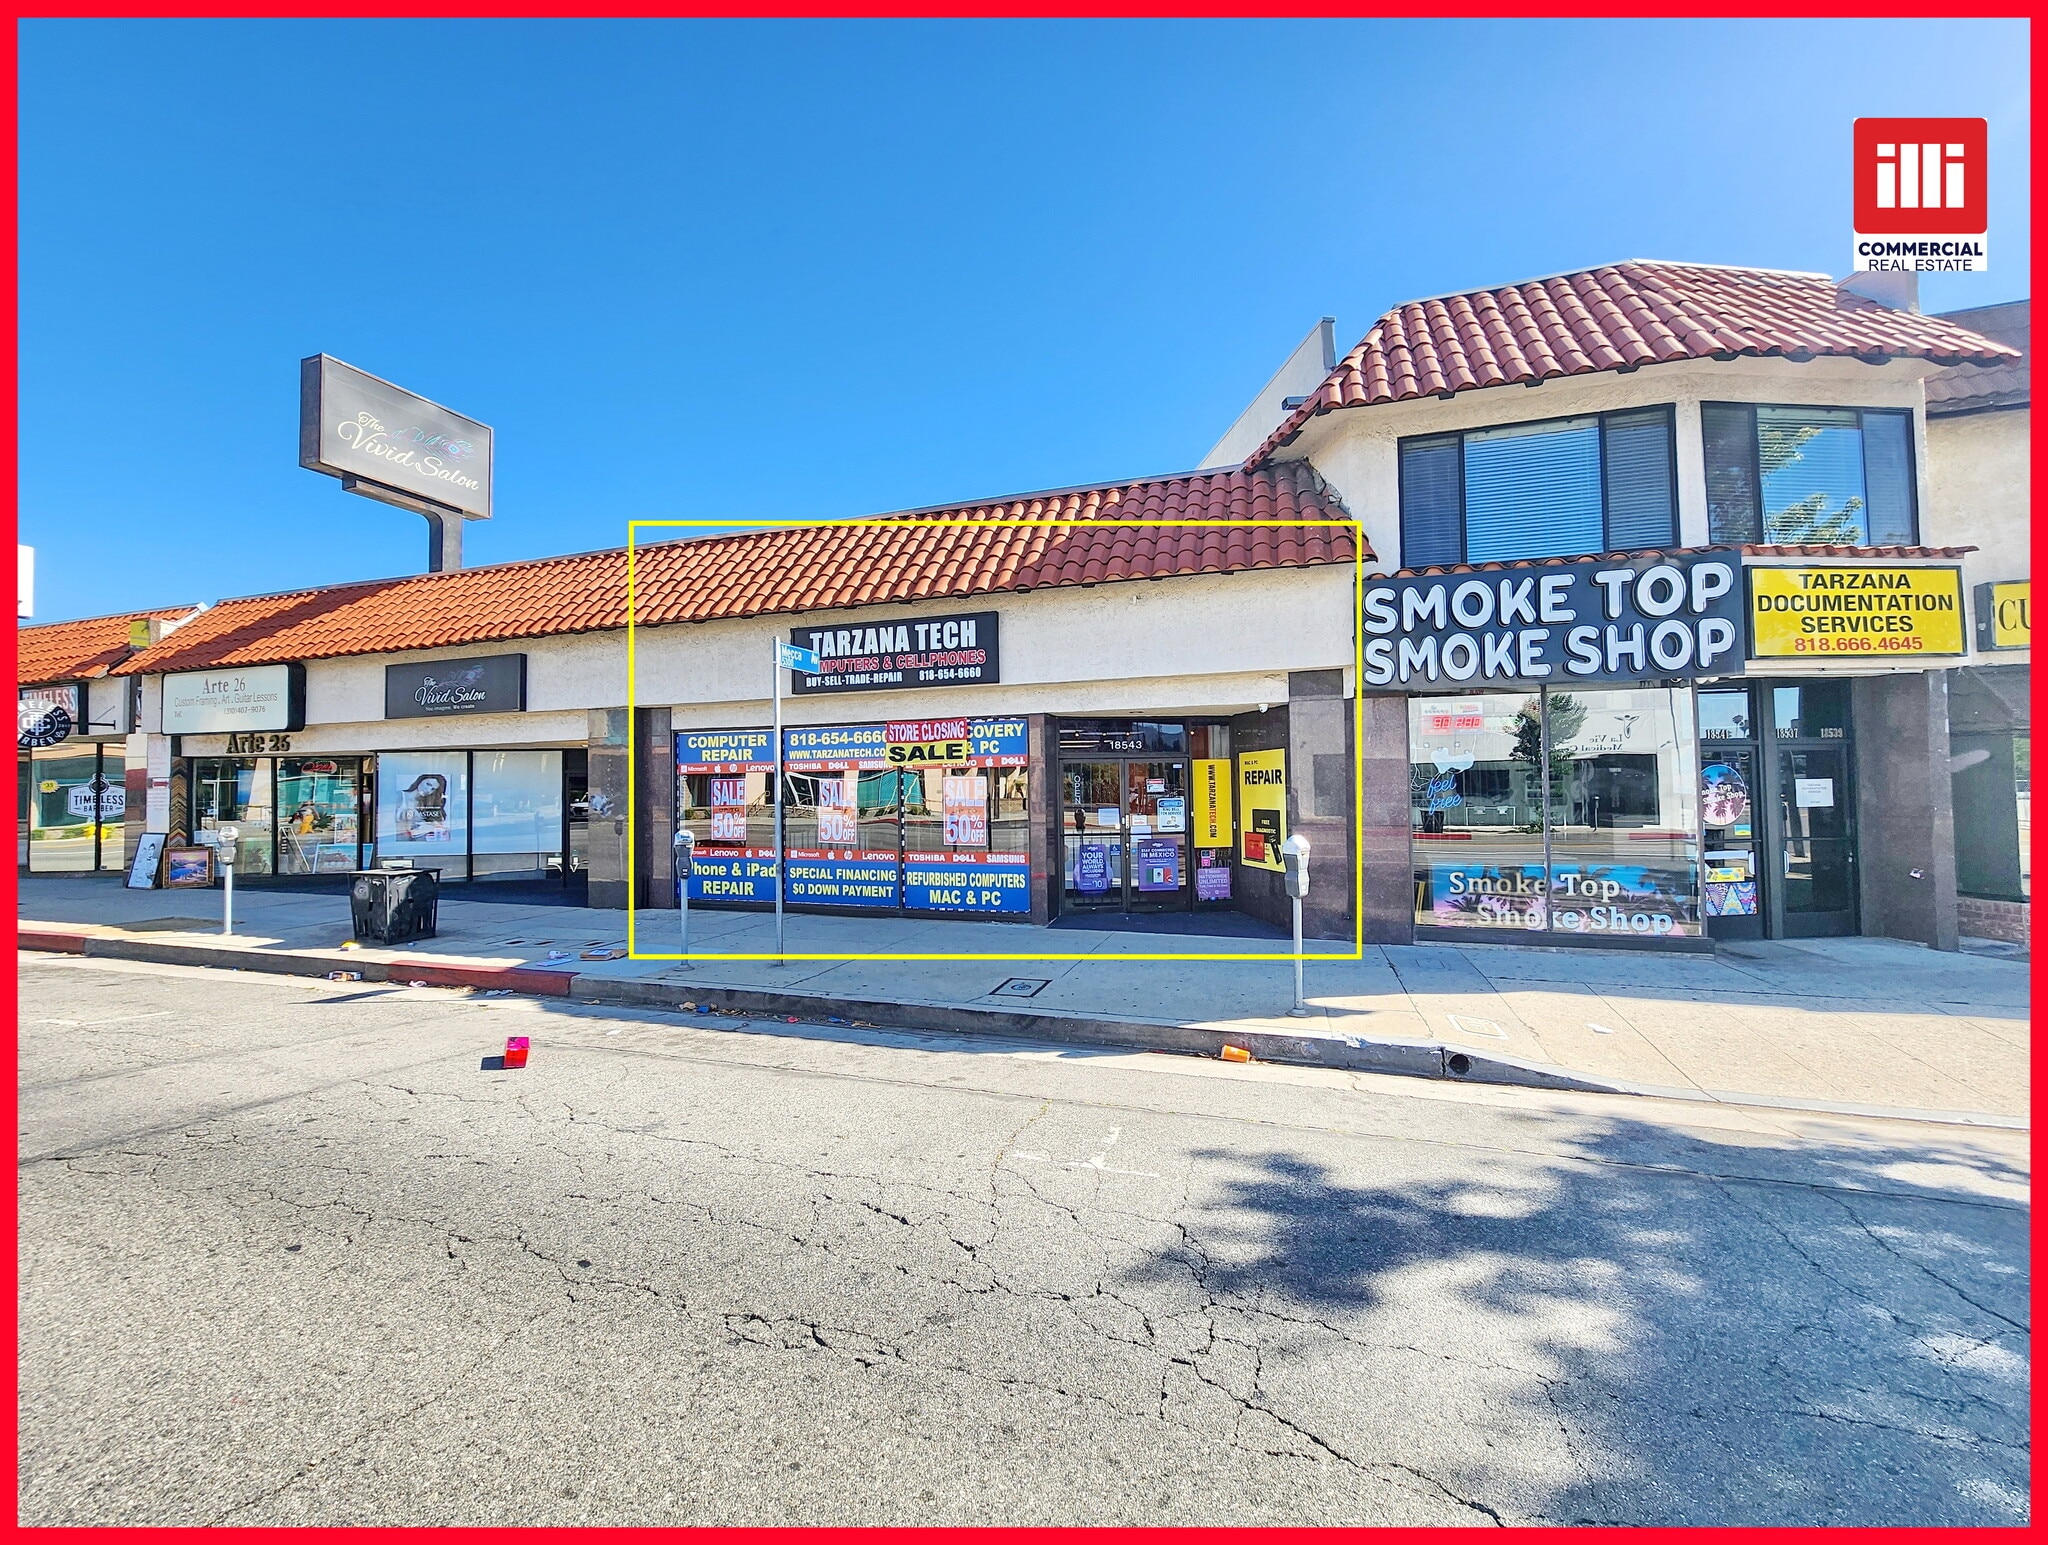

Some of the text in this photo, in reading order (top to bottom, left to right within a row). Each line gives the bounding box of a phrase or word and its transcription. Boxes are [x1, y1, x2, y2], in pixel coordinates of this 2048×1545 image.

[358, 411, 385, 432] The
[337, 421, 479, 490] Vivid Salon
[1798, 573, 1911, 589] TARZANA
[1363, 561, 1733, 635] SMOKE TOP
[1757, 594, 1953, 612] DOCUMENTATION
[1800, 615, 1914, 633] SERVICES
[809, 620, 976, 657] TARZANA TECH
[1794, 636, 1923, 652] 818.666.4645
[781, 645, 802, 661] Mecca
[1364, 618, 1736, 685] SMOKE SHOP
[819, 650, 986, 673] MPUTERS & CELLPHONES
[806, 667, 981, 688] BUY-SELL-TRADE-REPAIR 818-654-6660
[202, 677, 246, 695] Arte 26
[253, 692, 278, 703] Lessons
[415, 685, 487, 706] Vivid Salon
[1433, 716, 1482, 729] 90 280
[889, 721, 964, 742] STORE CLOSING
[1706, 729, 1729, 739] 18541
[1775, 728, 1798, 739] 18537
[226, 733, 290, 754] Arte 26
[687, 734, 767, 749] COMPUTER
[980, 740, 1000, 754] PC
[1109, 740, 1143, 750] 18543
[702, 749, 753, 762] REPAIR
[789, 747, 885, 760] WWW.TARZANATECH.CO
[889, 743, 964, 762] SALE
[1001, 756, 1025, 765] DELL
[745, 764, 775, 772] Lenovo
[1244, 769, 1283, 785] REPAIR
[713, 781, 744, 806] SALE
[821, 781, 855, 807] SALE
[946, 779, 984, 807] SALE
[1074, 775, 1082, 805] OPEN
[1427, 774, 1457, 798] feel
[1718, 784, 1732, 792] Top
[1726, 791, 1744, 799] Shop
[1429, 794, 1462, 815] free
[734, 826, 745, 838] OFF
[843, 828, 855, 841] OFF
[971, 830, 985, 843] OFF
[710, 848, 739, 857] Lenovo
[862, 852, 895, 861] Lenovo
[908, 854, 1026, 864] TOSHIBA DELL SAMSUNG
[693, 861, 776, 878] hone & iPad
[789, 867, 897, 882] SPECIAL FINANCING
[703, 880, 754, 896] REPAIR
[907, 871, 1026, 889] REFURBISHED COMPUTERS
[1450, 871, 1620, 902] Smoke Top
[792, 883, 894, 898] $0 DOWN PAYMENT
[929, 889, 1002, 906] MAC & PC
[1477, 904, 1673, 936] Smoke Shop
